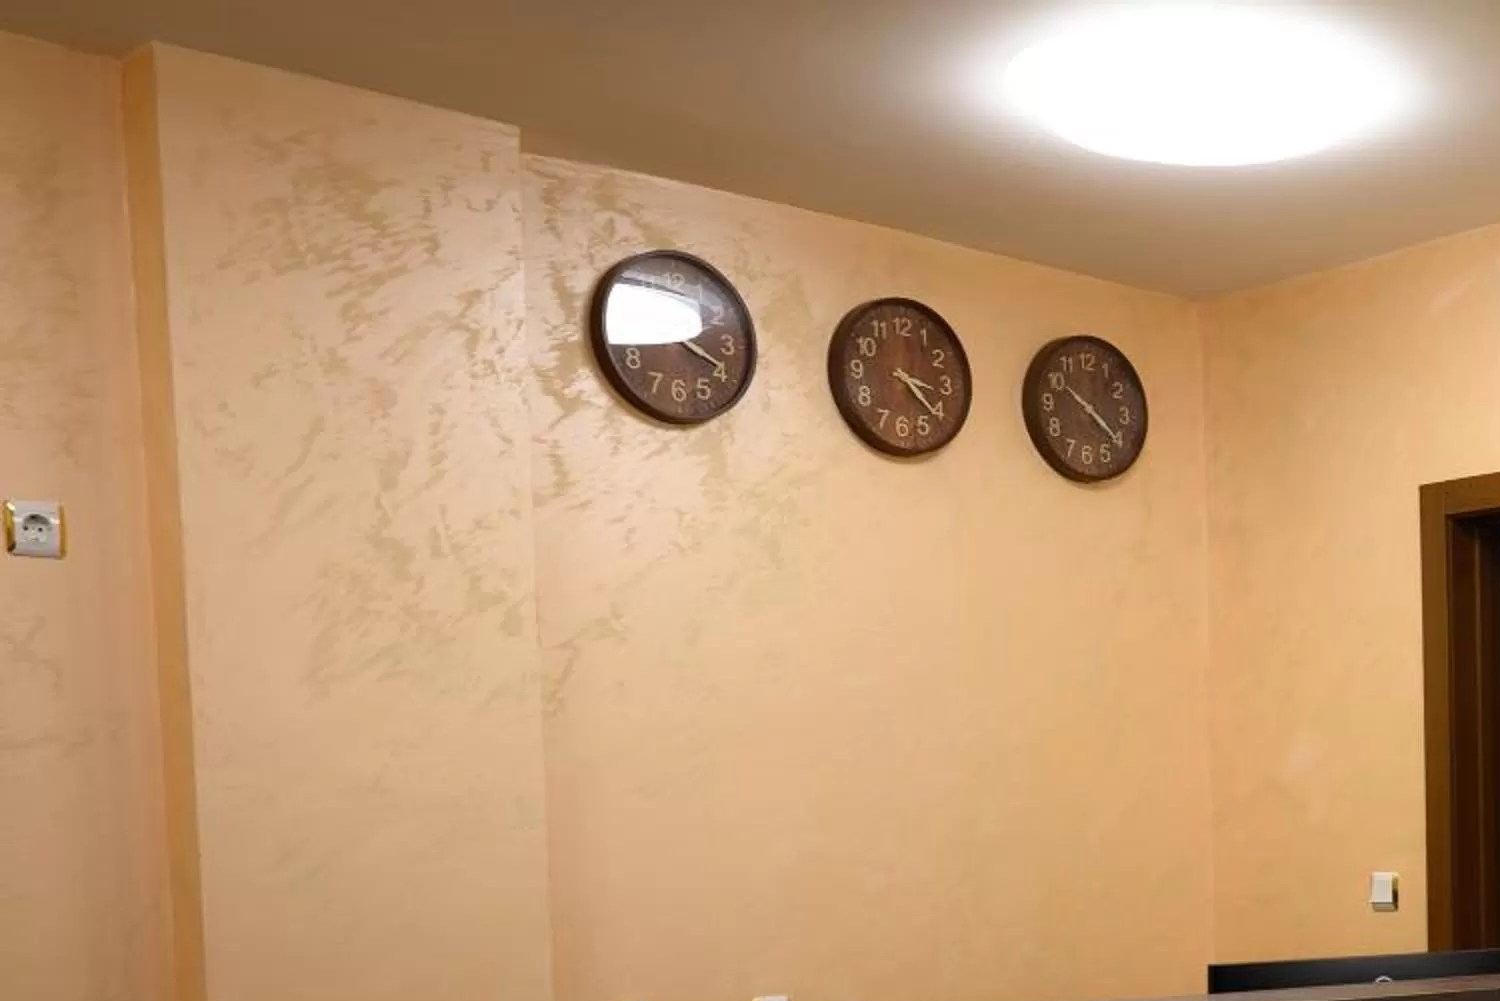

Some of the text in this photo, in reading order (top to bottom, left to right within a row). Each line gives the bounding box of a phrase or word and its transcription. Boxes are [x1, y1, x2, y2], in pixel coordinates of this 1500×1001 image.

[710, 304, 724, 326] 2
[872, 320, 887, 338] 11
[892, 317, 912, 337] 12
[720, 334, 735, 355] 3
[856, 336, 877, 357] 10
[920, 328, 928, 347] 1
[625, 347, 641, 369] 8
[932, 349, 945, 368] 2
[1060, 356, 1073, 373] 11
[1080, 353, 1096, 371] 12
[713, 361, 728, 382] 4
[851, 359, 863, 379] 9
[1102, 363, 1109, 379] 1
[648, 371, 664, 394] 7
[671, 379, 687, 401] 6
[696, 378, 711, 400] 5
[939, 376, 952, 395] 3
[1048, 372, 1065, 391] 10
[1112, 381, 1123, 399] 2
[858, 385, 871, 407] 8
[1043, 393, 1054, 411] 9
[876, 408, 891, 429] 7
[931, 401, 945, 420] 4
[1119, 406, 1130, 425] 3
[895, 416, 909, 437] 6
[917, 415, 930, 435] 5
[1049, 417, 1060, 437] 8
[1065, 438, 1076, 457] 7
[1082, 445, 1092, 465] 6
[1100, 443, 1111, 462] 5
